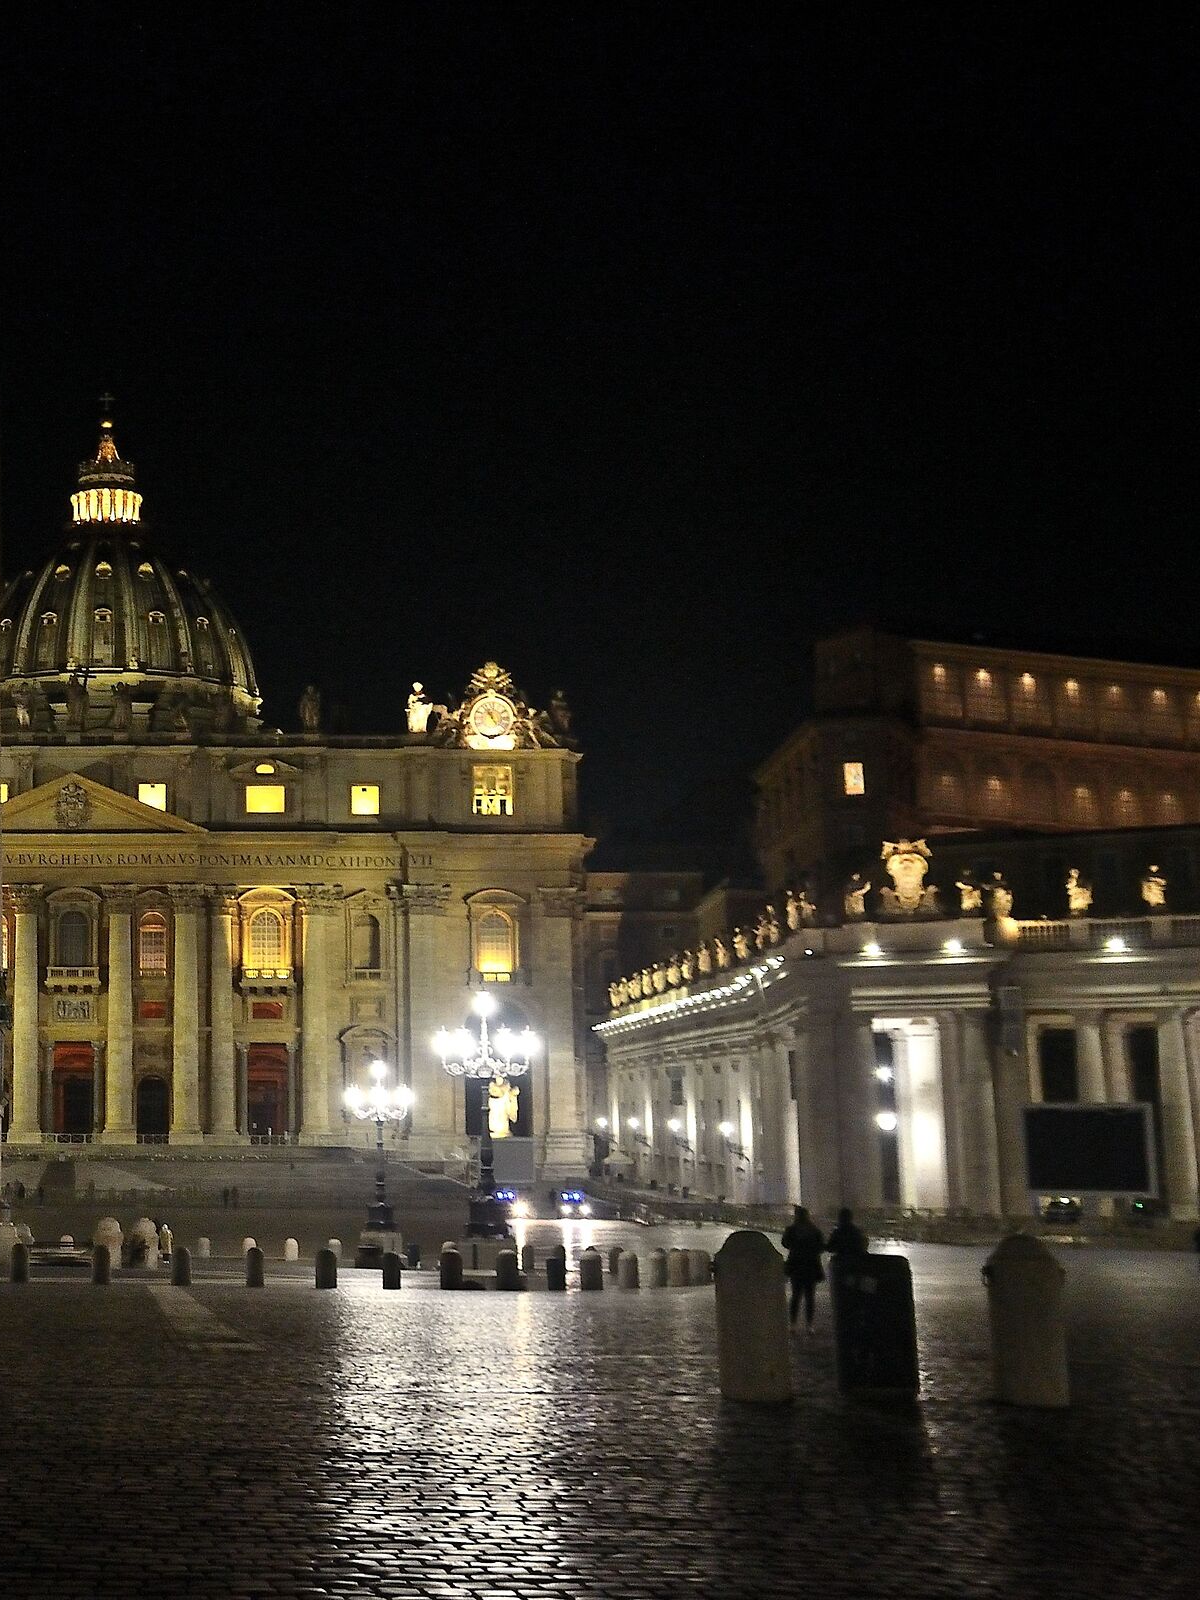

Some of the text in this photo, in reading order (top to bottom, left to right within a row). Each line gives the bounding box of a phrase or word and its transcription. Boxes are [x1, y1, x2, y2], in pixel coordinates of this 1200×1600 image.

[18, 853, 114, 865] BVRGHESIVS
[117, 853, 195, 865] ROMANVS
[240, 854, 273, 866] MAX
